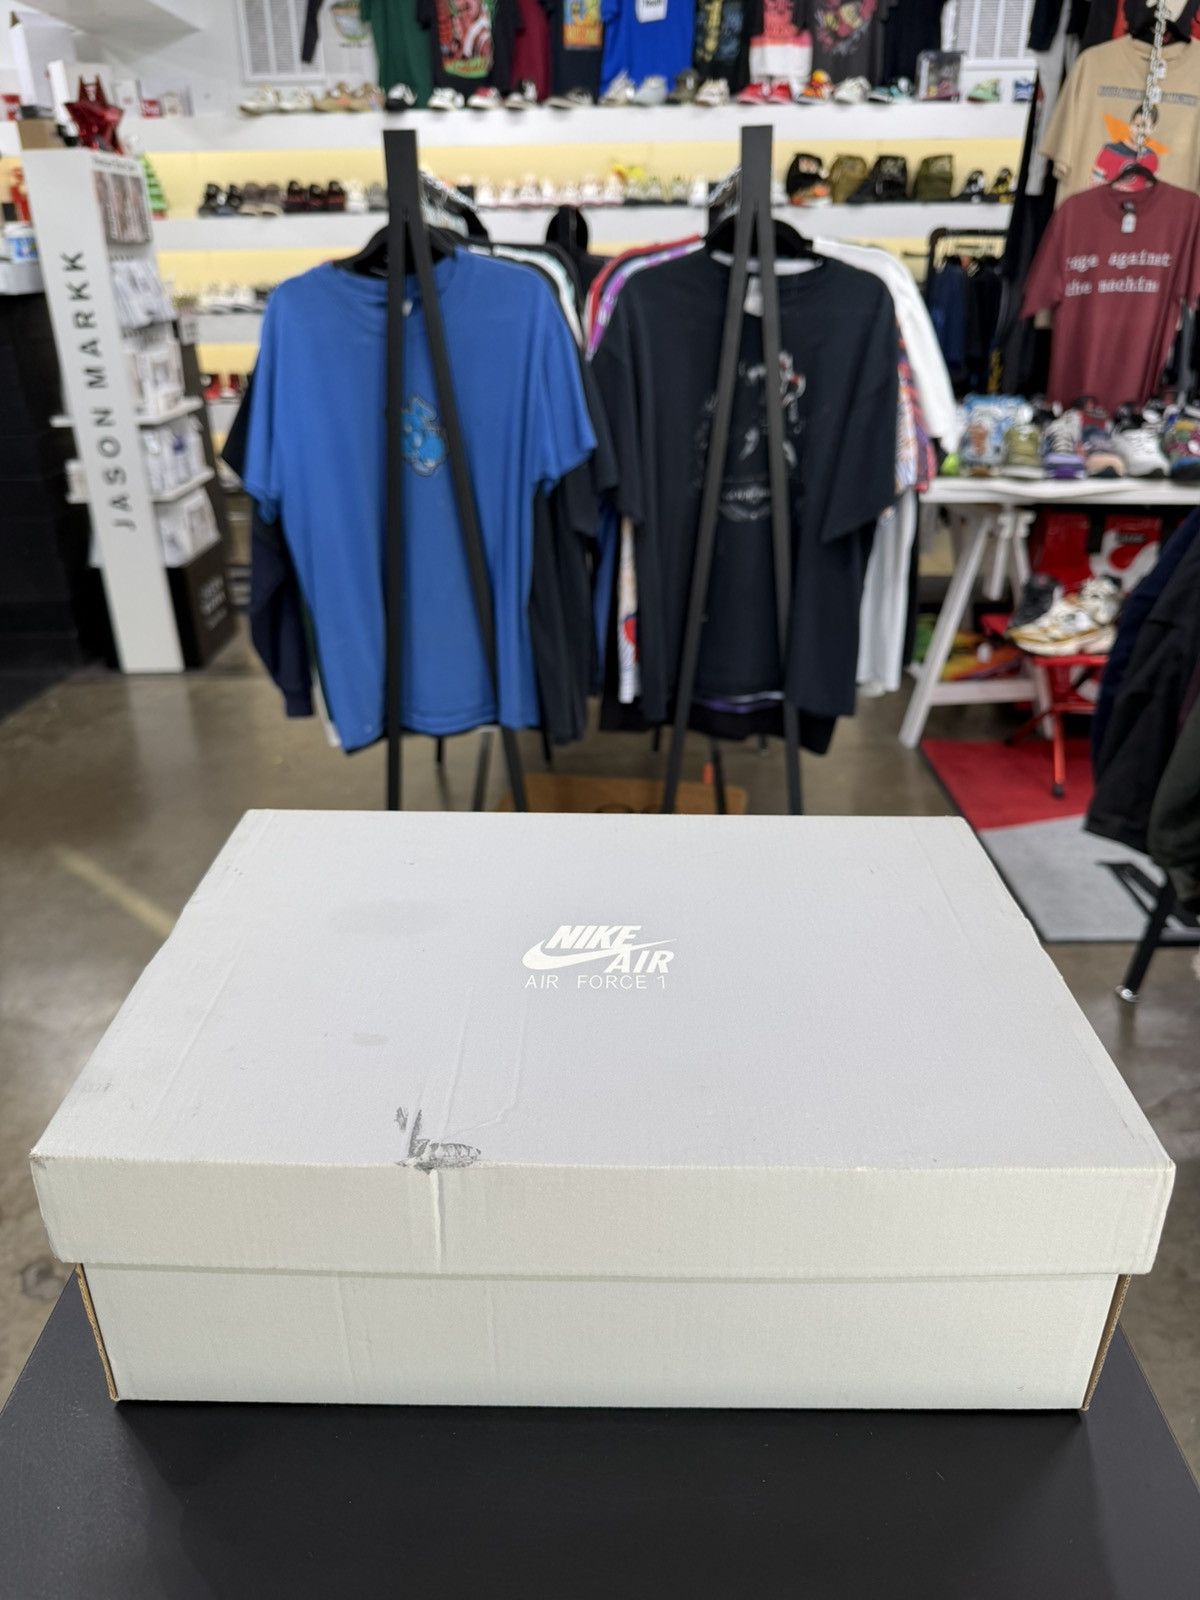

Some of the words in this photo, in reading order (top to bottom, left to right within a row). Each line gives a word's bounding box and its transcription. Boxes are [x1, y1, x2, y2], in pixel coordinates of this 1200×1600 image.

[1108, 249, 1171, 270] against
[1064, 278, 1092, 297] the
[61, 252, 109, 389] MARKK
[91, 406, 137, 532] JASON
[545, 925, 642, 950] NIKE
[603, 949, 675, 974] AIR
[524, 974, 560, 990] AIR
[577, 974, 648, 990] FORCE
[657, 974, 666, 990] 1
